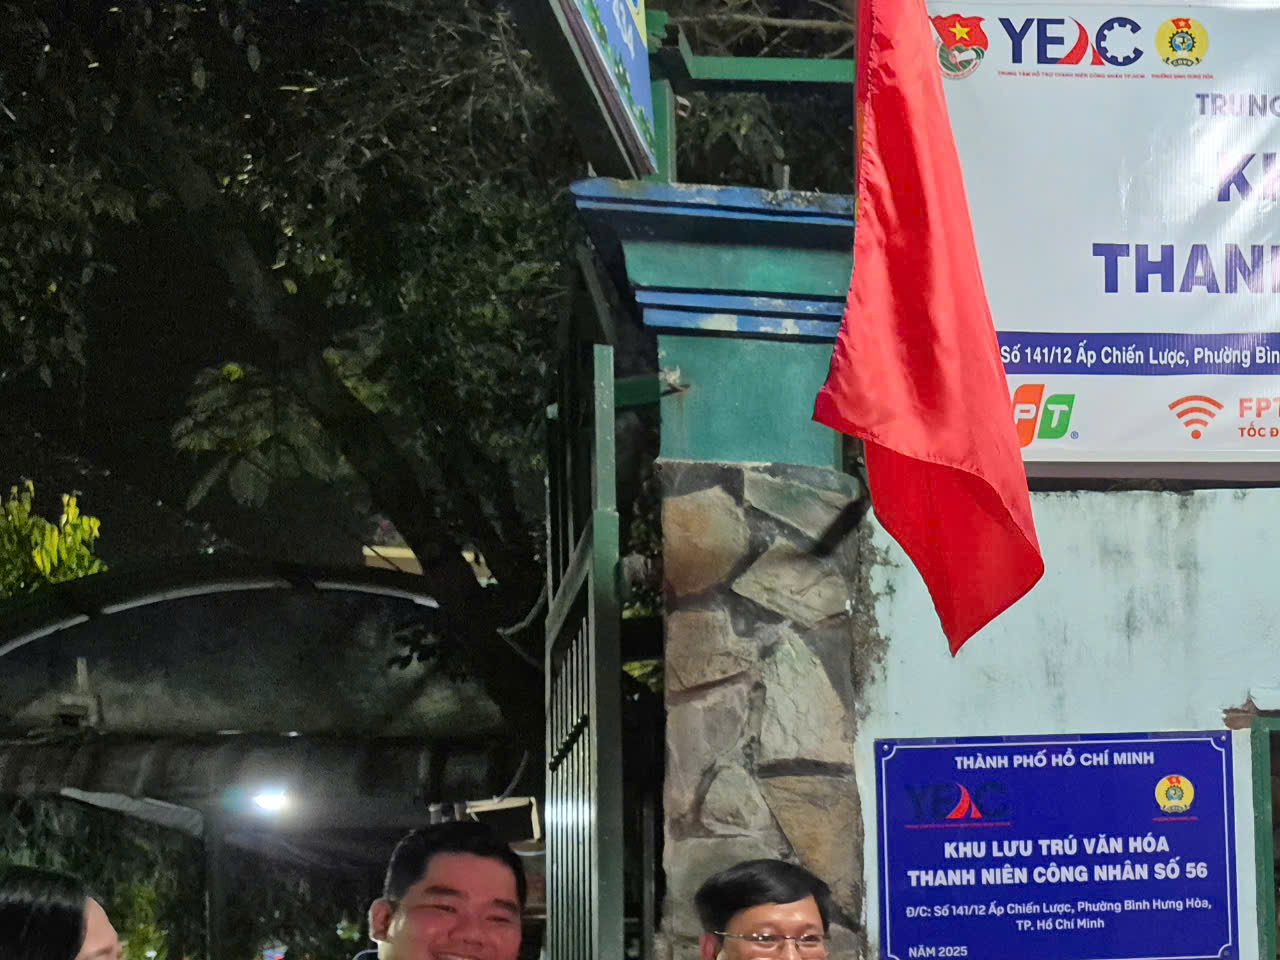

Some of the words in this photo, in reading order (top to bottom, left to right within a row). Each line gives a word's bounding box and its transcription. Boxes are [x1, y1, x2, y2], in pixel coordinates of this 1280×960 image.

[1000, 343, 1021, 364] Số
[1025, 347, 1072, 364] 141/12
[1076, 340, 1097, 367] Ấp
[1101, 344, 1144, 364] Chiến
[1149, 347, 1189, 367] Lược,
[1194, 345, 1251, 367] Phường
[1239, 422, 1266, 438] TỐC
[955, 753, 1008, 769] THÀNH
[1013, 749, 1047, 768] PHỐ
[1051, 748, 1075, 766] HỒ
[1080, 750, 1109, 766] CHÍ
[1113, 752, 1154, 765] MINH
[944, 841, 986, 859] KHU
[992, 839, 1033, 857] LƯU
[1038, 834, 1077, 856] TRÚ
[1083, 834, 1123, 854] VĂN
[1129, 832, 1169, 853] HÓA
[907, 869, 976, 886] THANH
[981, 863, 1028, 885] NIÊN
[1033, 862, 1088, 883] CÔNG
[1094, 860, 1148, 881] NHÂN
[1154, 856, 1180, 879] SỐ
[1186, 862, 1208, 879] 56
[906, 906, 931, 918] Đ/C:
[934, 904, 949, 917] Số
[952, 904, 986, 916] 141/12
[988, 900, 1004, 916] Ấp
[1007, 901, 1040, 914] Chiến
[1043, 902, 1075, 915] Lược,
[1078, 900, 1122, 913] Phường
[1124, 899, 1150, 910] Bình
[1153, 899, 1183, 911] Hưng
[1186, 898, 1212, 910] Hòa,
[1016, 919, 1034, 931] TP.
[1056, 918, 1074, 930] Chí
[1077, 918, 1104, 929] Minh
[908, 945, 936, 958] NĂM
[938, 946, 968, 957] 2025
